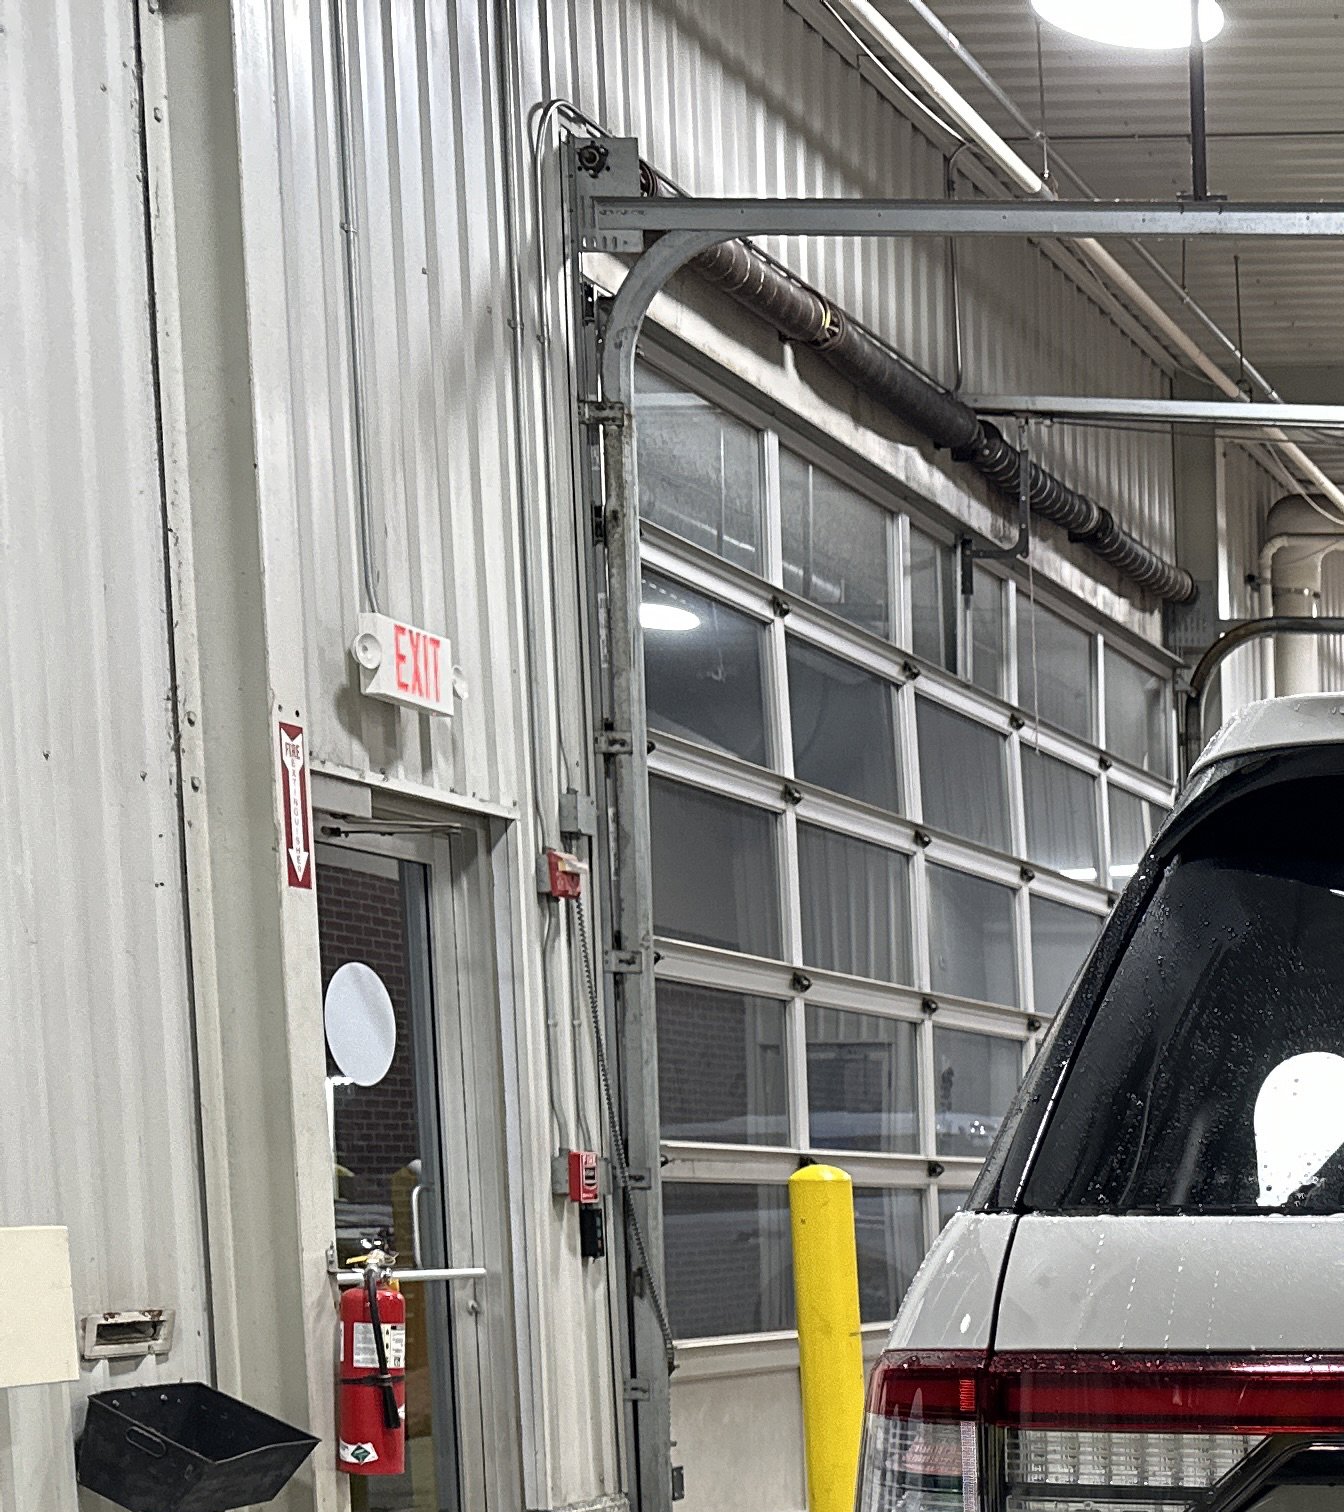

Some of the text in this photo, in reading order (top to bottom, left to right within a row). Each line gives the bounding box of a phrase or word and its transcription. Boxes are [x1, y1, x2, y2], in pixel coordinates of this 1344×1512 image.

[393, 623, 441, 703] EXIT
[285, 741, 301, 760] FIRE
[290, 758, 303, 874] EXTINGUISHER
